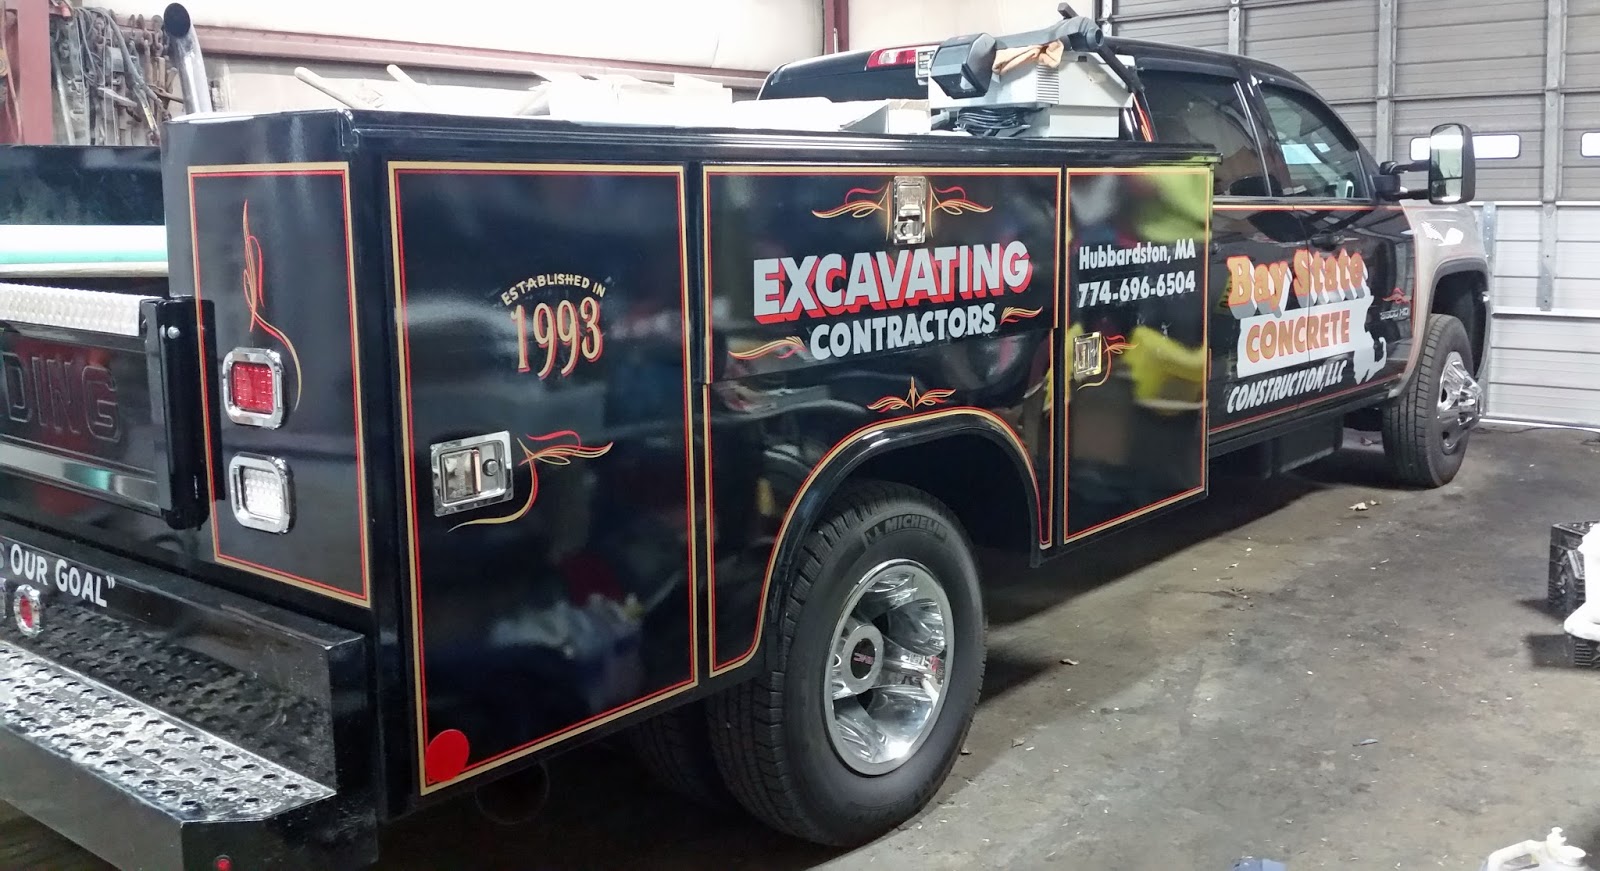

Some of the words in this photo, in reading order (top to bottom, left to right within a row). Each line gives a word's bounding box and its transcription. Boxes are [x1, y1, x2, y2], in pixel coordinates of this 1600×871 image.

[1079, 242, 1171, 270] Hubbardston,
[1174, 238, 1196, 260] MA
[501, 273, 590, 306] ESTABLISHED
[592, 282, 606, 298] IN
[753, 240, 1033, 324] EXCAVATING
[1078, 270, 1196, 308] 774-696-6504
[1227, 255, 1291, 318] Bay
[1293, 248, 1367, 304] State
[510, 296, 604, 380] 1993
[810, 303, 996, 360] CONTRACTORS
[1246, 310, 1350, 363] CONCRETE
[1324, 360, 1348, 388] LLC
[884, 513, 946, 540] MICHELIN
[10, 543, 48, 586] OUR
